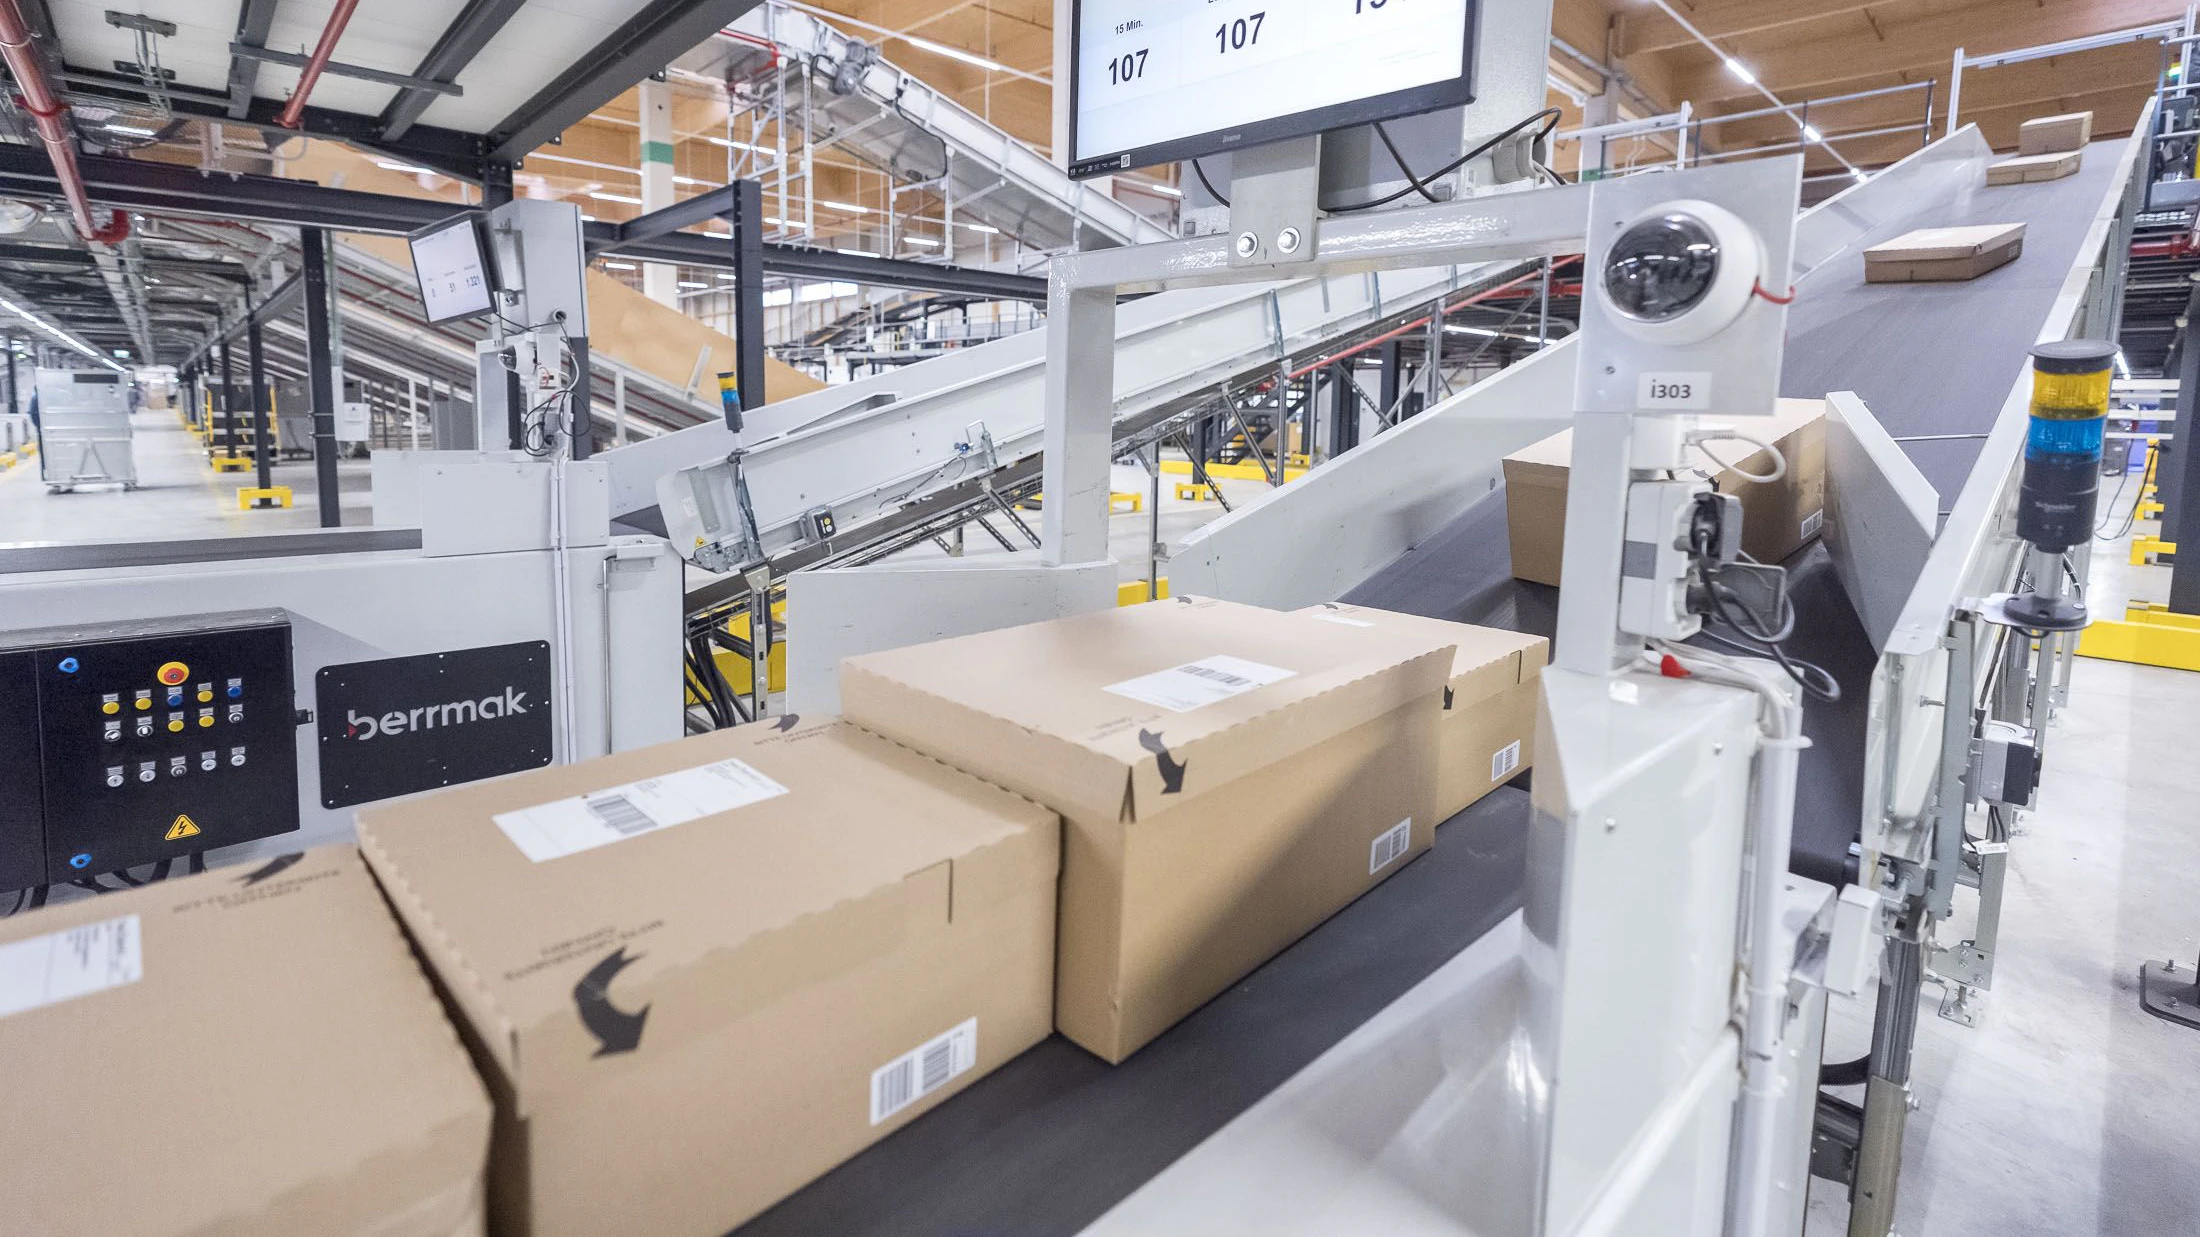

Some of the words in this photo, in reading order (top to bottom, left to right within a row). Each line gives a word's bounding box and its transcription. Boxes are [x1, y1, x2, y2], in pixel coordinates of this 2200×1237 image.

[1115, 23, 1124, 35] 15
[1126, 19, 1144, 32] Min.
[1216, 11, 1266, 54] 107
[1108, 48, 1149, 85] 107
[1651, 379, 1691, 399] i303
[347, 686, 528, 741] berrmak
